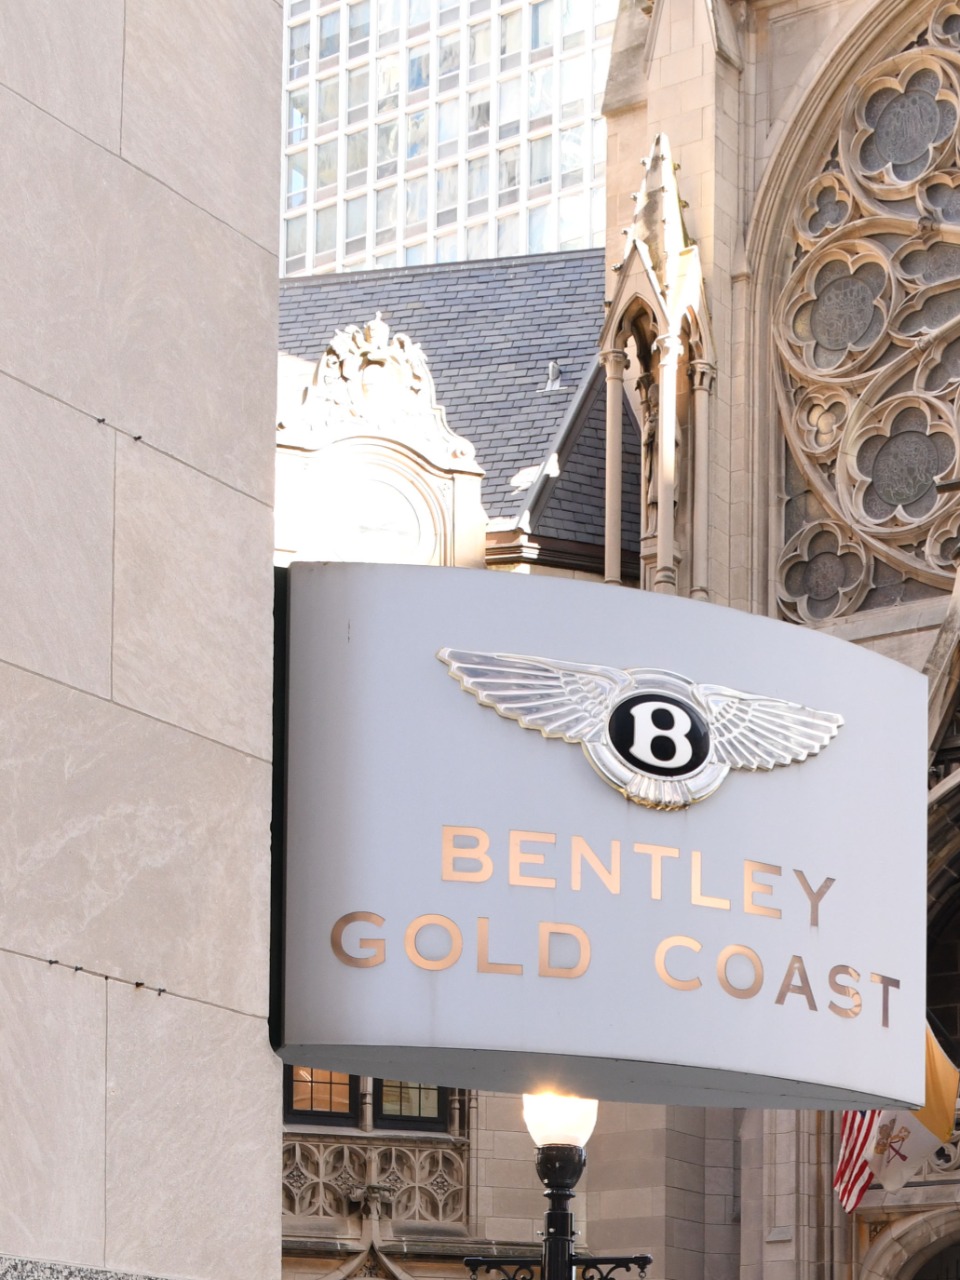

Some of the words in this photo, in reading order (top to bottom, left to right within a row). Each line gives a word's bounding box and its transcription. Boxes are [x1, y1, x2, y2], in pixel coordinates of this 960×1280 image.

[629, 700, 693, 768] B
[441, 824, 837, 927] BENTLEY
[330, 910, 591, 979] GOLD
[654, 935, 901, 1028] COAST
